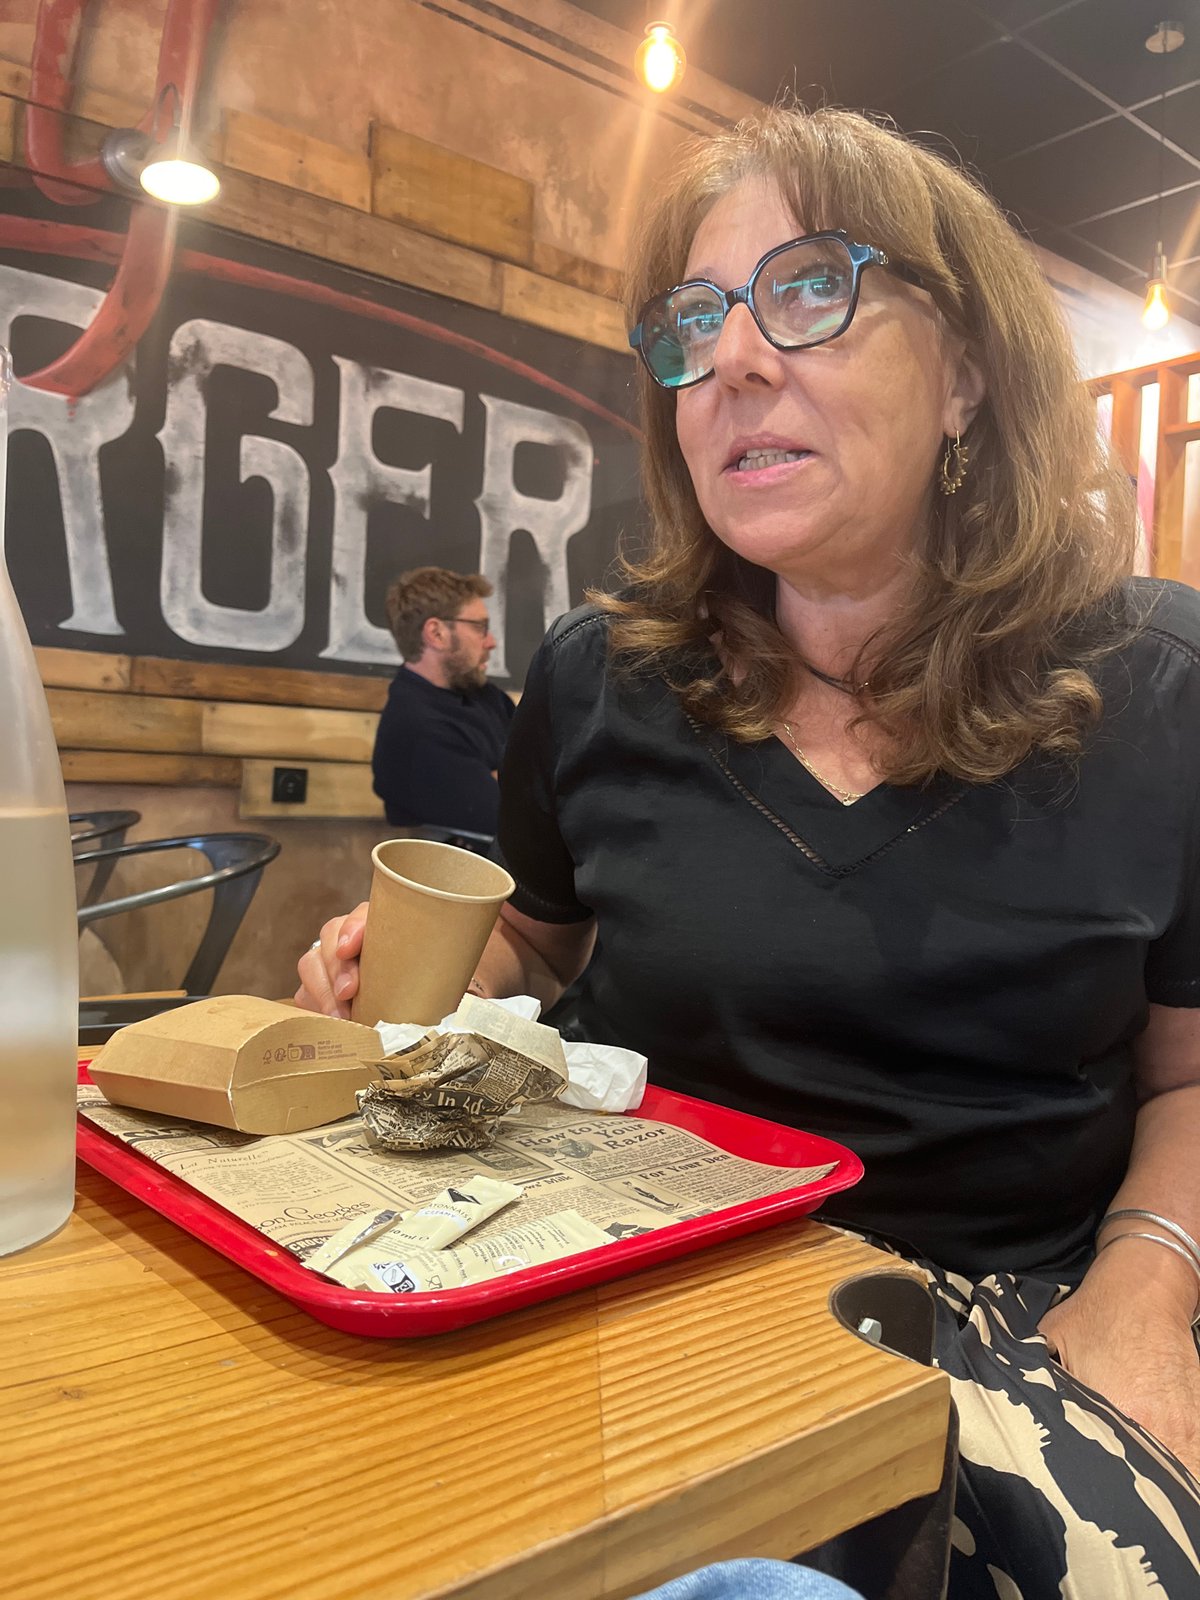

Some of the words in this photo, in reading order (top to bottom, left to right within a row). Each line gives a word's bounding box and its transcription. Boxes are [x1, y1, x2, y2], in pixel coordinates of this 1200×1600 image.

[516, 1132, 567, 1148] How
[569, 1125, 593, 1135] to
[594, 1122, 646, 1139] Your
[603, 1127, 668, 1150] Razor
[638, 1169, 666, 1180] For
[667, 1161, 702, 1173] Your
[702, 1153, 733, 1165] Den
